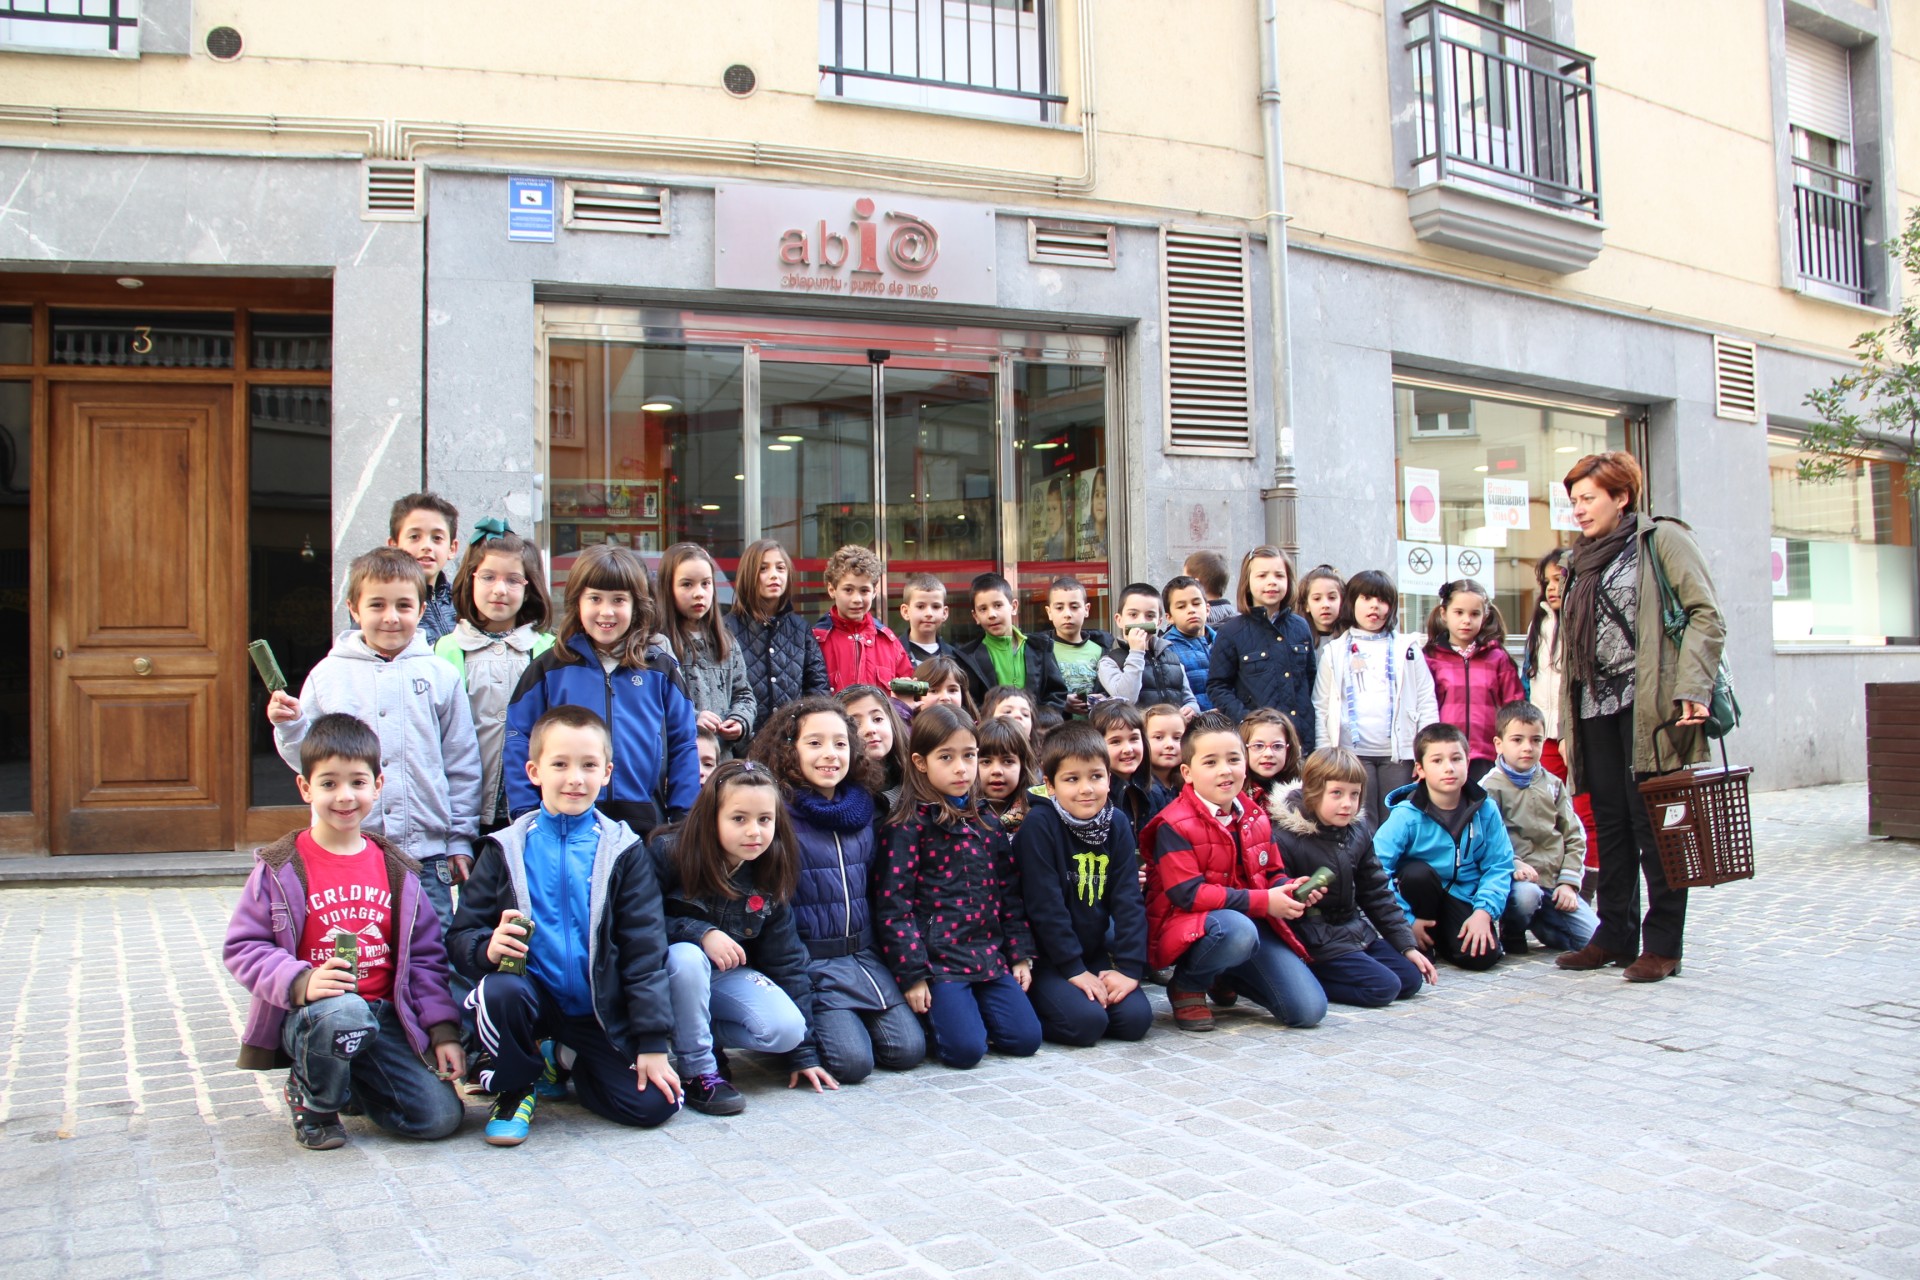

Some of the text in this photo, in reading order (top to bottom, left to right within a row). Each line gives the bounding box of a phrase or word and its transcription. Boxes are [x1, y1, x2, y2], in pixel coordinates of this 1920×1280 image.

[781, 273, 842, 292] abiapuntu
[851, 279, 886, 295] punto
[889, 280, 904, 294] de
[132, 326, 152, 354] 3
[319, 907, 385, 926] VOYAGER
